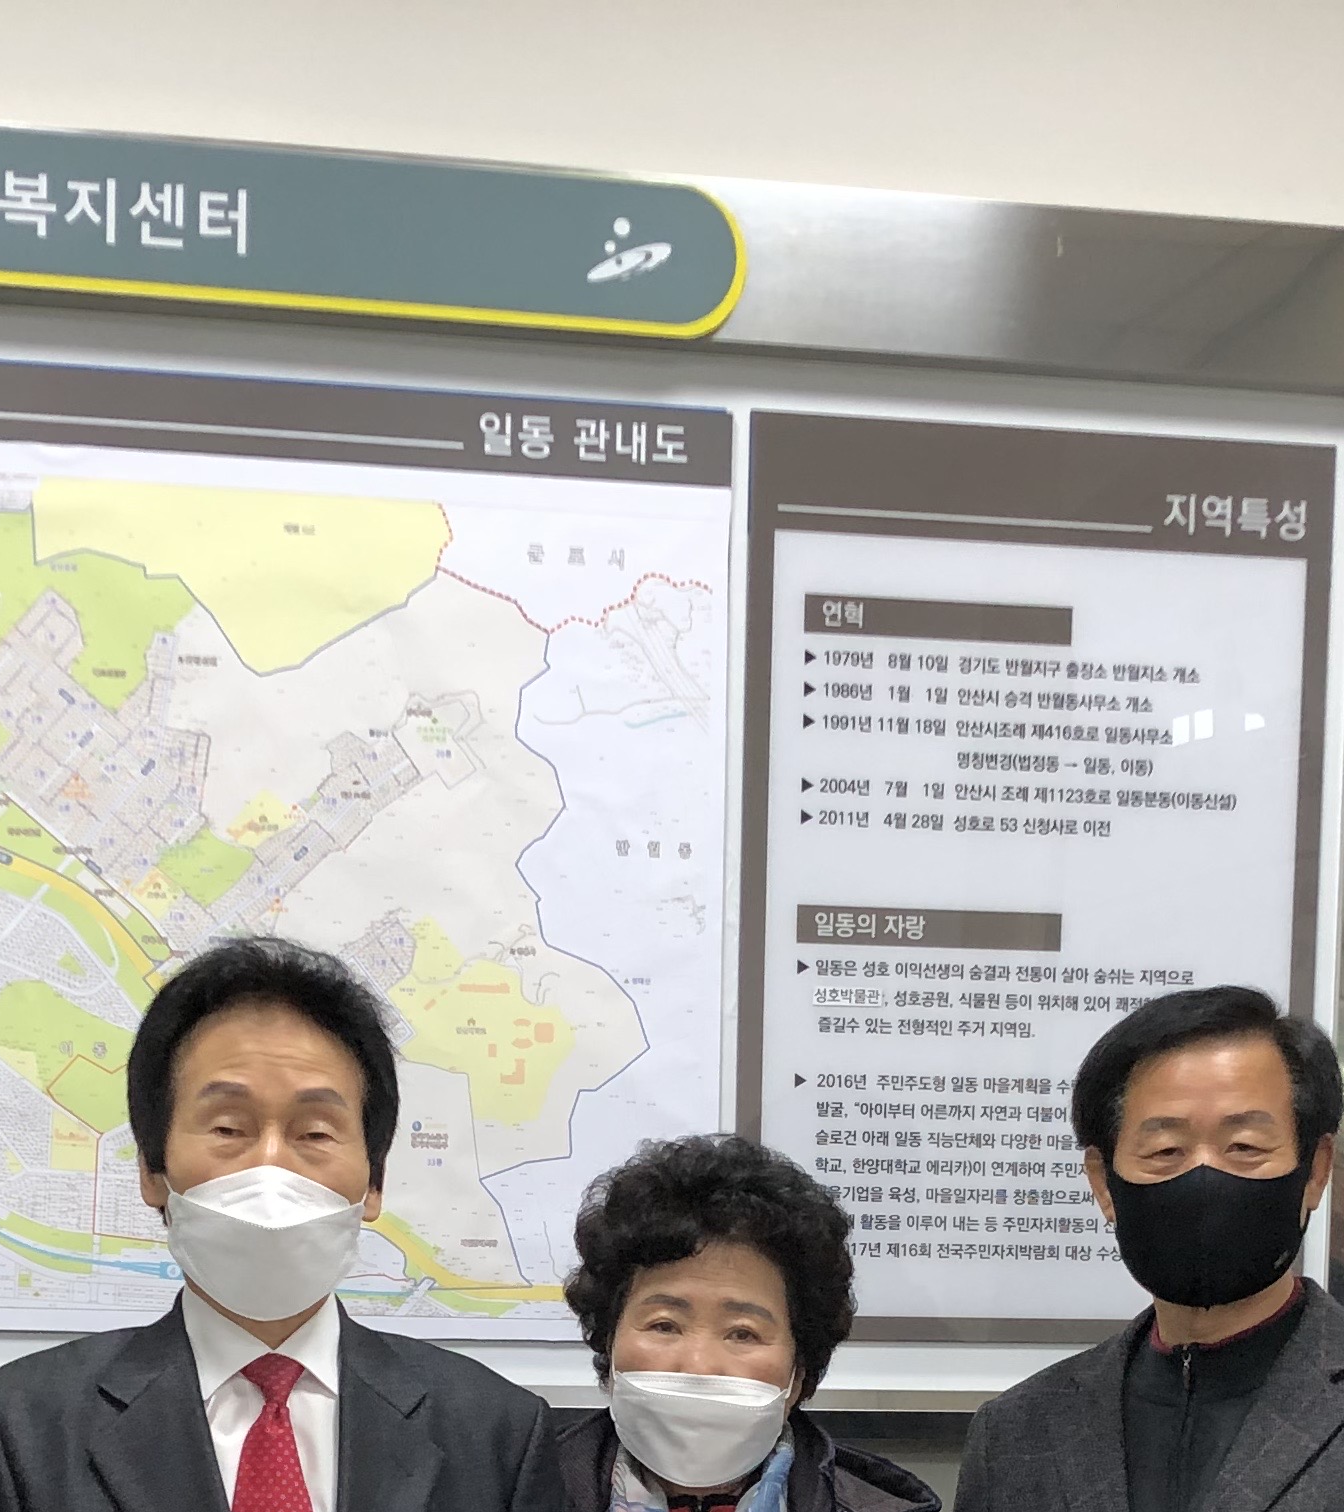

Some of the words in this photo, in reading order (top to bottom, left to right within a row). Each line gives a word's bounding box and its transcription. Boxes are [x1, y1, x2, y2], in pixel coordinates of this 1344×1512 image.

[479, 412, 554, 459] 일동
[573, 418, 689, 464] 관내도
[1164, 492, 1308, 541] 지역특성
[822, 600, 864, 629] 연혁
[824, 651, 874, 669] 1979년
[888, 653, 912, 671] 8월
[918, 654, 948, 673] 10일
[959, 656, 1000, 674] 경기도
[1005, 658, 1061, 677] 반월지구
[1173, 666, 1201, 684] 개소
[824, 683, 873, 701] 1986년
[889, 685, 910, 703] 1월
[926, 687, 948, 704] 1일
[957, 688, 999, 707] 안산시
[1005, 691, 1032, 708] 승격
[1037, 693, 1121, 711] 반월동사무소
[1126, 696, 1153, 713] 개소
[822, 715, 872, 733] 1991년
[878, 717, 909, 734] 11월
[915, 719, 946, 737] 18일
[956, 720, 1026, 740] 안산시조례
[1031, 724, 1099, 742] 제416호로
[1105, 727, 1173, 746] 일동사무소
[1084, 757, 1115, 776] 일동,
[1121, 758, 1154, 777] 이동)
[820, 778, 870, 796] 2004년
[885, 781, 907, 798] 7월
[924, 782, 945, 800] 1일
[955, 784, 997, 801] 안산시
[1001, 786, 1029, 803] 조례
[1034, 787, 1112, 805] 제1123호로
[1116, 790, 1237, 811] 일동분동(이동신설)
[819, 810, 869, 828] 2011년
[883, 812, 907, 830] 4월
[912, 814, 944, 831] 28일
[953, 815, 995, 832] 성호로
[1000, 818, 1018, 832] 53
[1023, 818, 1078, 835] 신청사로
[1083, 820, 1111, 837] 이전
[815, 912, 876, 938] 일동의
[884, 915, 925, 940] 자랑
[816, 959, 857, 976] 일동은
[862, 961, 890, 977] 성호
[895, 962, 964, 980] 이익선생의
[969, 964, 1010, 982] 숨결과
[1016, 966, 1056, 983] 전통이
[1062, 967, 1089, 983] 살아
[1094, 968, 1134, 985] 숨쉬는
[1139, 970, 1194, 985] 지역으로
[894, 991, 953, 1008] 성호공원,
[959, 992, 1000, 1009] 식물원
[1005, 994, 1032, 1010] 등이
[1038, 995, 1078, 1011] 위치해
[1083, 996, 1110, 1012] 있어
[1115, 997, 1154, 1012] 쾌적
[818, 1017, 860, 1033] 즐길수
[865, 1018, 892, 1034] 있는
[898, 1019, 952, 1036] 전형적인
[957, 1021, 985, 1036] 주거
[990, 1022, 1036, 1038] 지역임.
[817, 1074, 866, 1090] 2016년
[876, 1075, 945, 1092] 주민주도형
[951, 1076, 978, 1092] 일동
[984, 1078, 1051, 1094] 마을계획을
[817, 1101, 848, 1118] 발굴,
[921, 1104, 975, 1120] 어른까지
[980, 1106, 1021, 1121] 자연과
[1027, 1107, 1067, 1122] 더불어
[815, 1130, 856, 1145] 슬로건
[862, 1131, 889, 1146] 아래
[895, 1131, 922, 1147] 일동
[927, 1132, 995, 1149] 직능단체와
[1001, 1134, 1041, 1150] 다양한
[815, 1158, 846, 1174] 학교,
[853, 1158, 921, 1175] 한양대학교
[927, 1160, 986, 1176] 에리카)이
[991, 1161, 1046, 1177] 연계하여
[828, 1186, 883, 1202] 을기업을
[888, 1187, 920, 1203] 육성,
[926, 1188, 1008, 1204] 마을일자리를
[1013, 1189, 1094, 1205] 창출함으로써
[860, 1214, 901, 1230] 활동을
[907, 1215, 947, 1231] 이루어
[953, 1216, 979, 1232] 내는
[985, 1217, 997, 1232] 등
[1003, 1217, 1098, 1233] 주민자치활동의
[886, 1243, 931, 1258] 제16회
[937, 1243, 1060, 1260] 전국주민자치박람회
[1066, 1245, 1091, 1261] 대상
[1096, 1247, 1122, 1262] 수상
